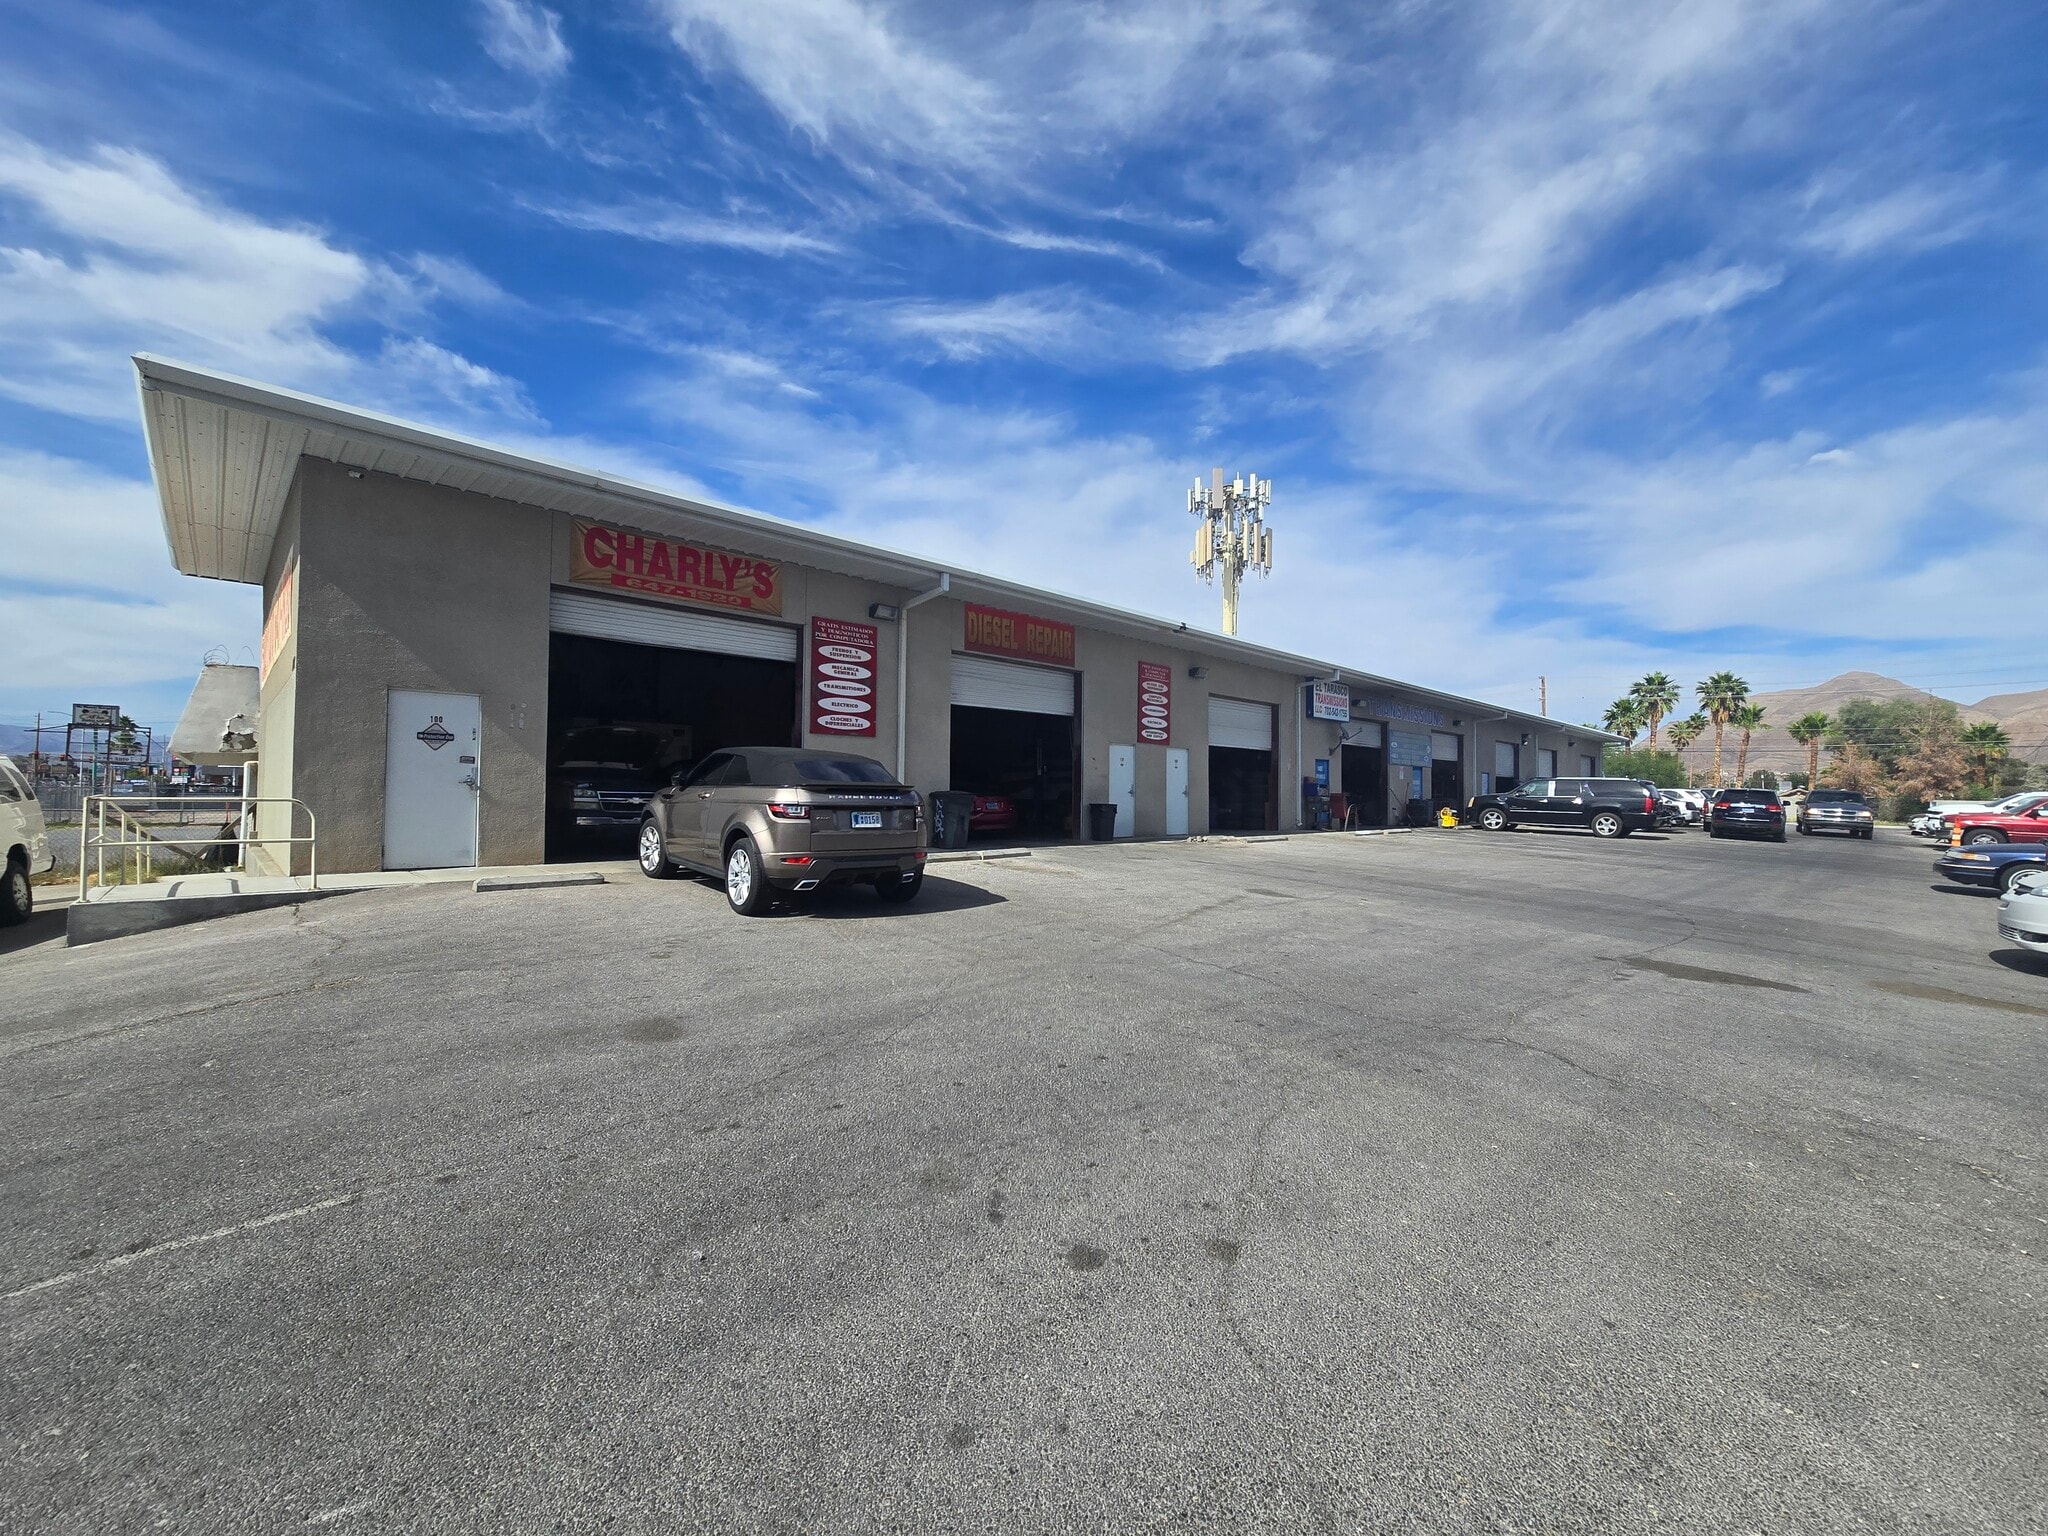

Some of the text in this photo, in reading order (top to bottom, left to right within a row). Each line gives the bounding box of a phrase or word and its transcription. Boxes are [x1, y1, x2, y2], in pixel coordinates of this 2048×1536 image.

[584, 526, 774, 599] CHARLY'S
[817, 620, 874, 635] GRATIS ESTIMADOS
[828, 628, 869, 639] DIAGNOSTICOS
[968, 611, 1072, 659] DIESEL REPAIR
[829, 633, 874, 645] COMPUTADORA
[829, 651, 861, 660] SUSPENSION
[831, 647, 853, 655] FRENOS
[831, 665, 860, 673] MECANICA
[833, 669, 858, 677] GENERAL
[831, 701, 859, 709] ELECTRICO
[430, 715, 443, 723] 100
